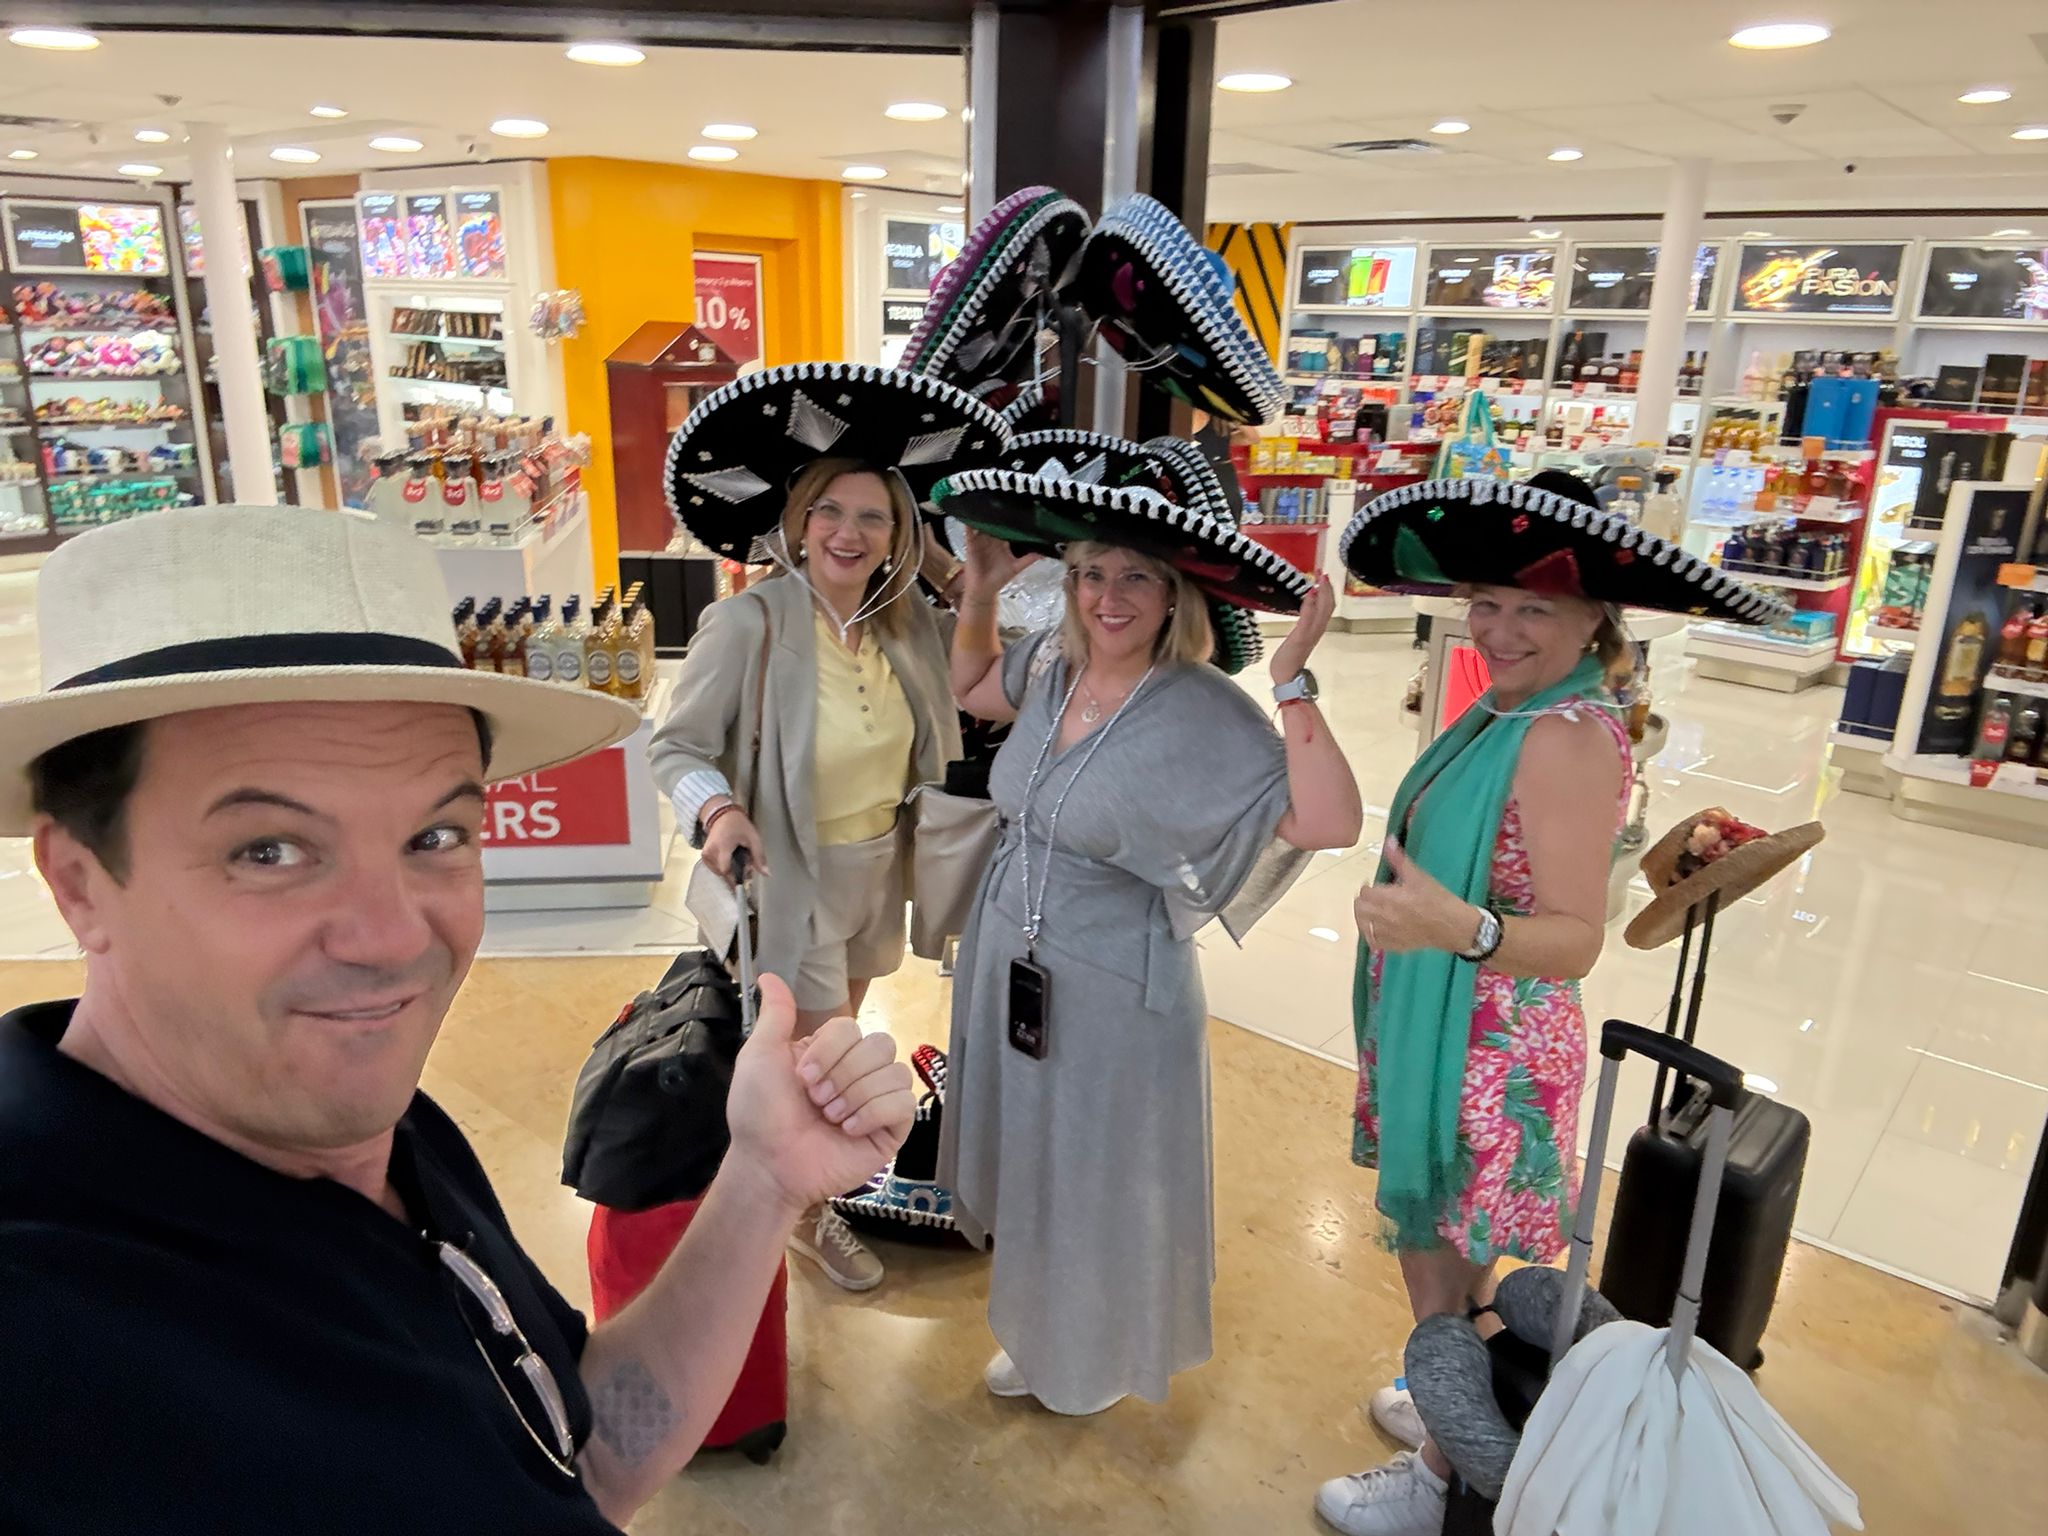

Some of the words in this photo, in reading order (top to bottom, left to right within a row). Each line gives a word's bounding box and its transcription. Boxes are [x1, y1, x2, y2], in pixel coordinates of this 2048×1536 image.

[1800, 271, 1897, 296] PASIÓN
[1803, 267, 1860, 281] PURA
[694, 296, 751, 330] 10%
